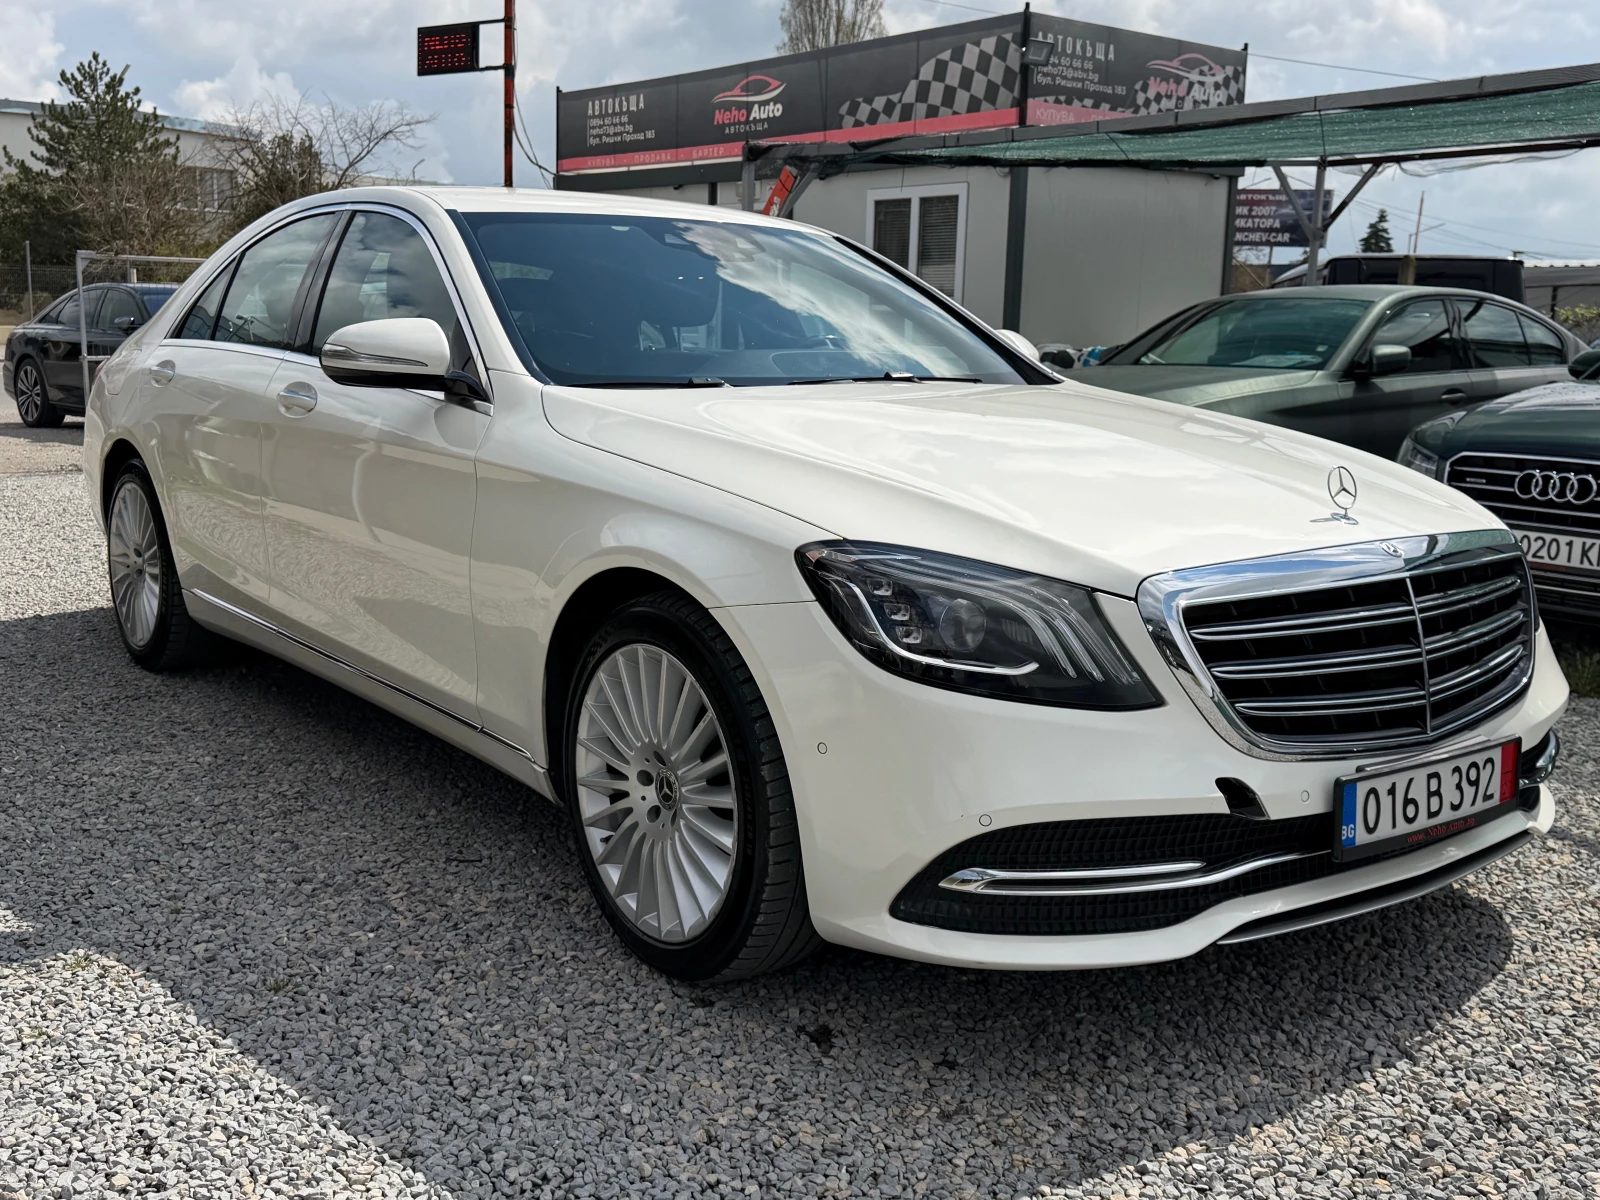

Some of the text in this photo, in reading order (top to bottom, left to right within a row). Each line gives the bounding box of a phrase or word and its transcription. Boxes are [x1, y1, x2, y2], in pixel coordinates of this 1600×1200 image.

[1060, 56, 1071, 66] 60
[1072, 58, 1082, 69] 66
[1083, 60, 1094, 70] 66
[1037, 66, 1099, 82] neho73@abv.bg
[1055, 77, 1083, 88] Ришки
[1084, 81, 1113, 94] Проход
[1114, 85, 1127, 95] 183
[1188, 82, 1223, 102] Auto
[587, 93, 645, 116] АВТОКЪЩА
[589, 117, 604, 127] 0894
[604, 116, 612, 125] 60
[621, 114, 629, 123] 66
[713, 101, 783, 126] Neho Auto
[1036, 108, 1075, 121] КУПУВА
[589, 124, 634, 135] neho73@abv.bg
[724, 121, 769, 134] АВТОКЪЩА
[602, 135, 621, 144] Ришки
[622, 132, 645, 142] Проход
[645, 129, 656, 139] 183
[634, 152, 672, 163] ПРОДАВА
[692, 147, 725, 158] БАРТЕР
[1251, 206, 1277, 216] 2007
[1342, 824, 1356, 840] BG
